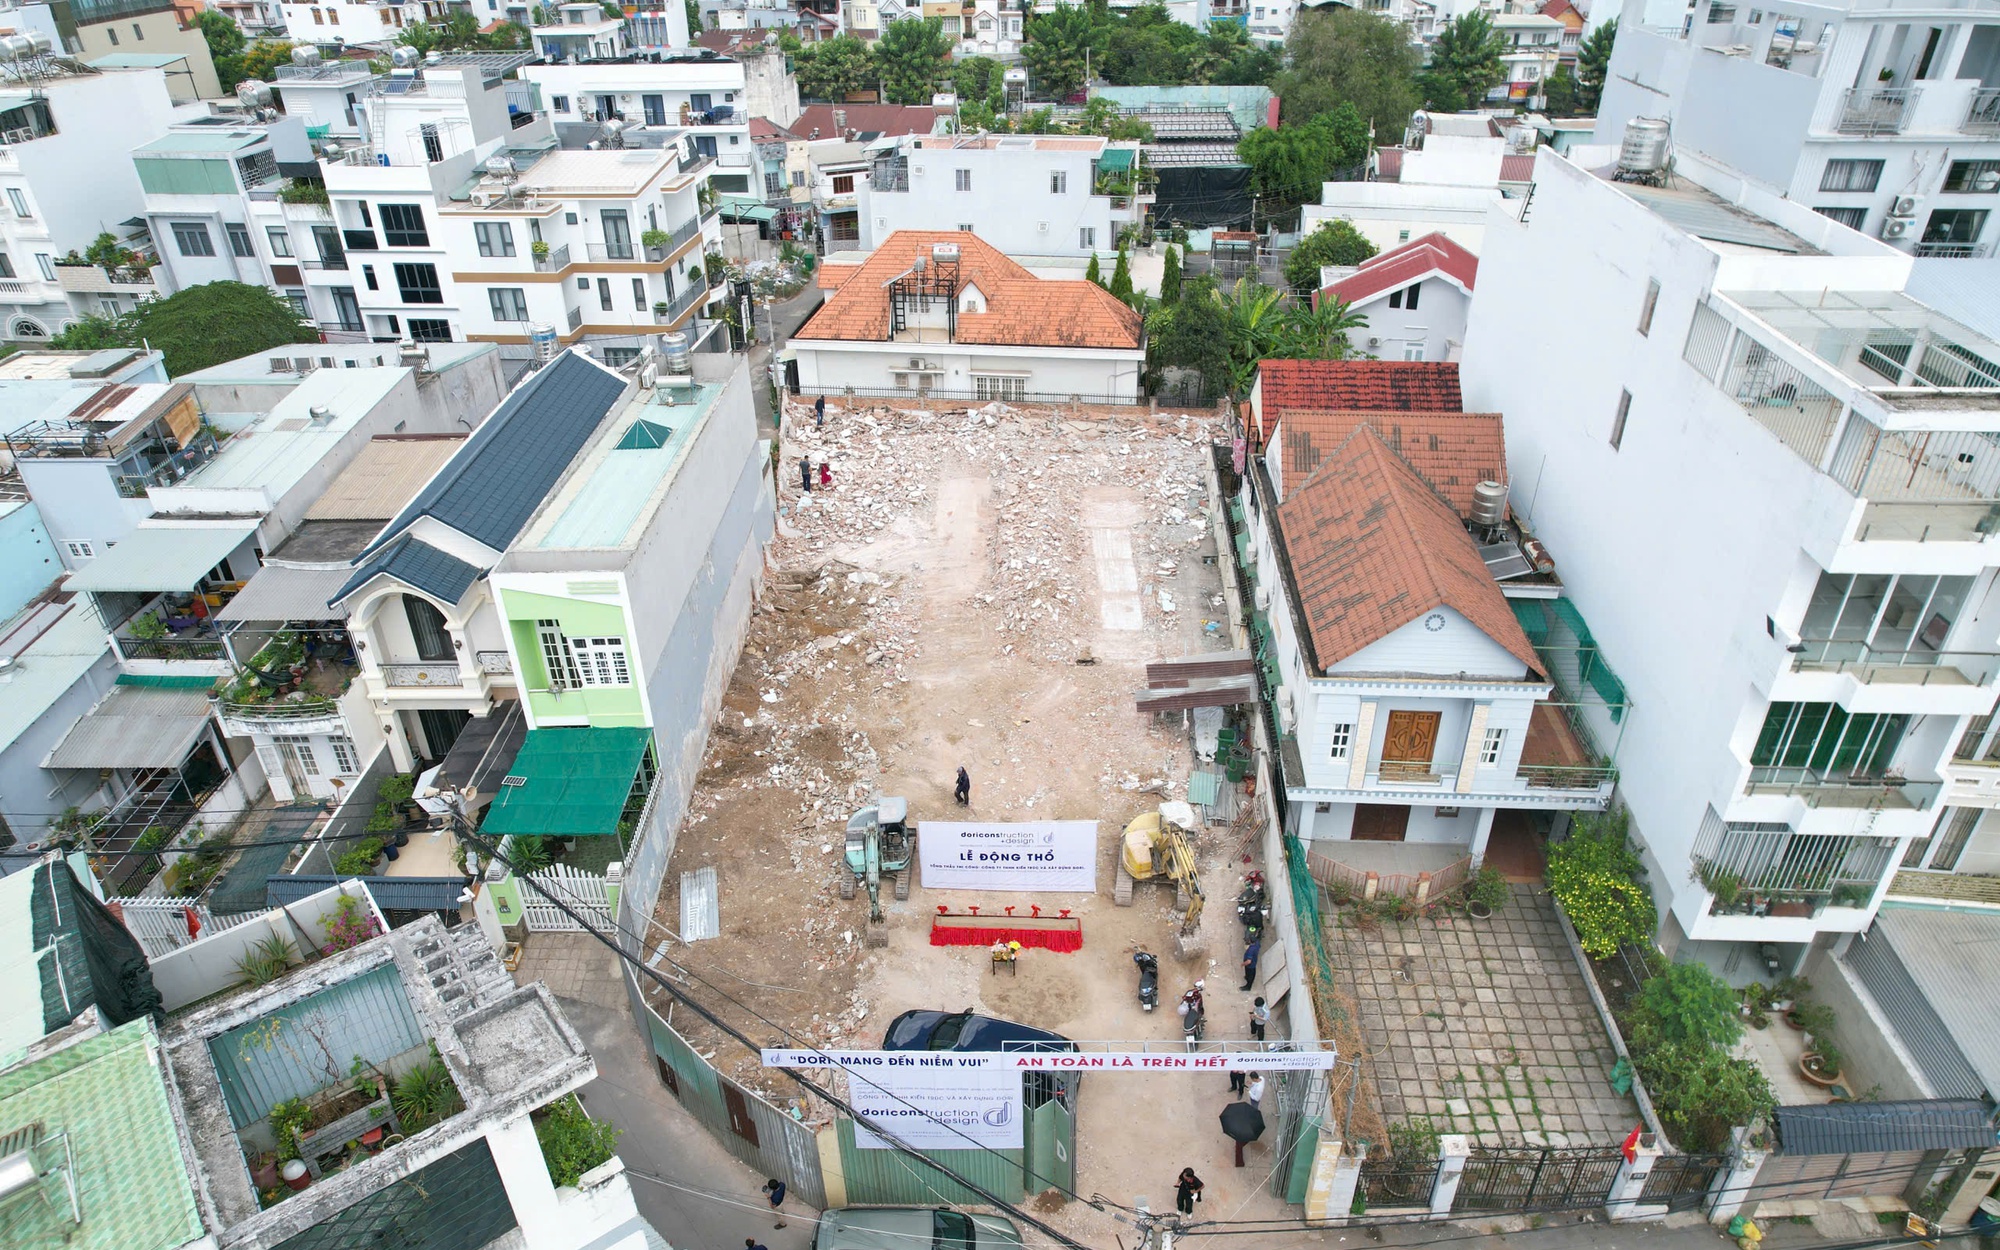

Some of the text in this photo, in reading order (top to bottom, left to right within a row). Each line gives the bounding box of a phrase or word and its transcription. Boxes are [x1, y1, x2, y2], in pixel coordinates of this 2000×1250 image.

[960, 848, 1054, 863] LỄ ĐỘNG THỔ
[840, 1057, 883, 1066] MANG
[888, 1054, 915, 1066] ĐẾN
[1017, 1054, 1228, 1067] AN TOÀN LÀ TRÊN HẾT
[861, 1108, 979, 1117] doriconstruction
